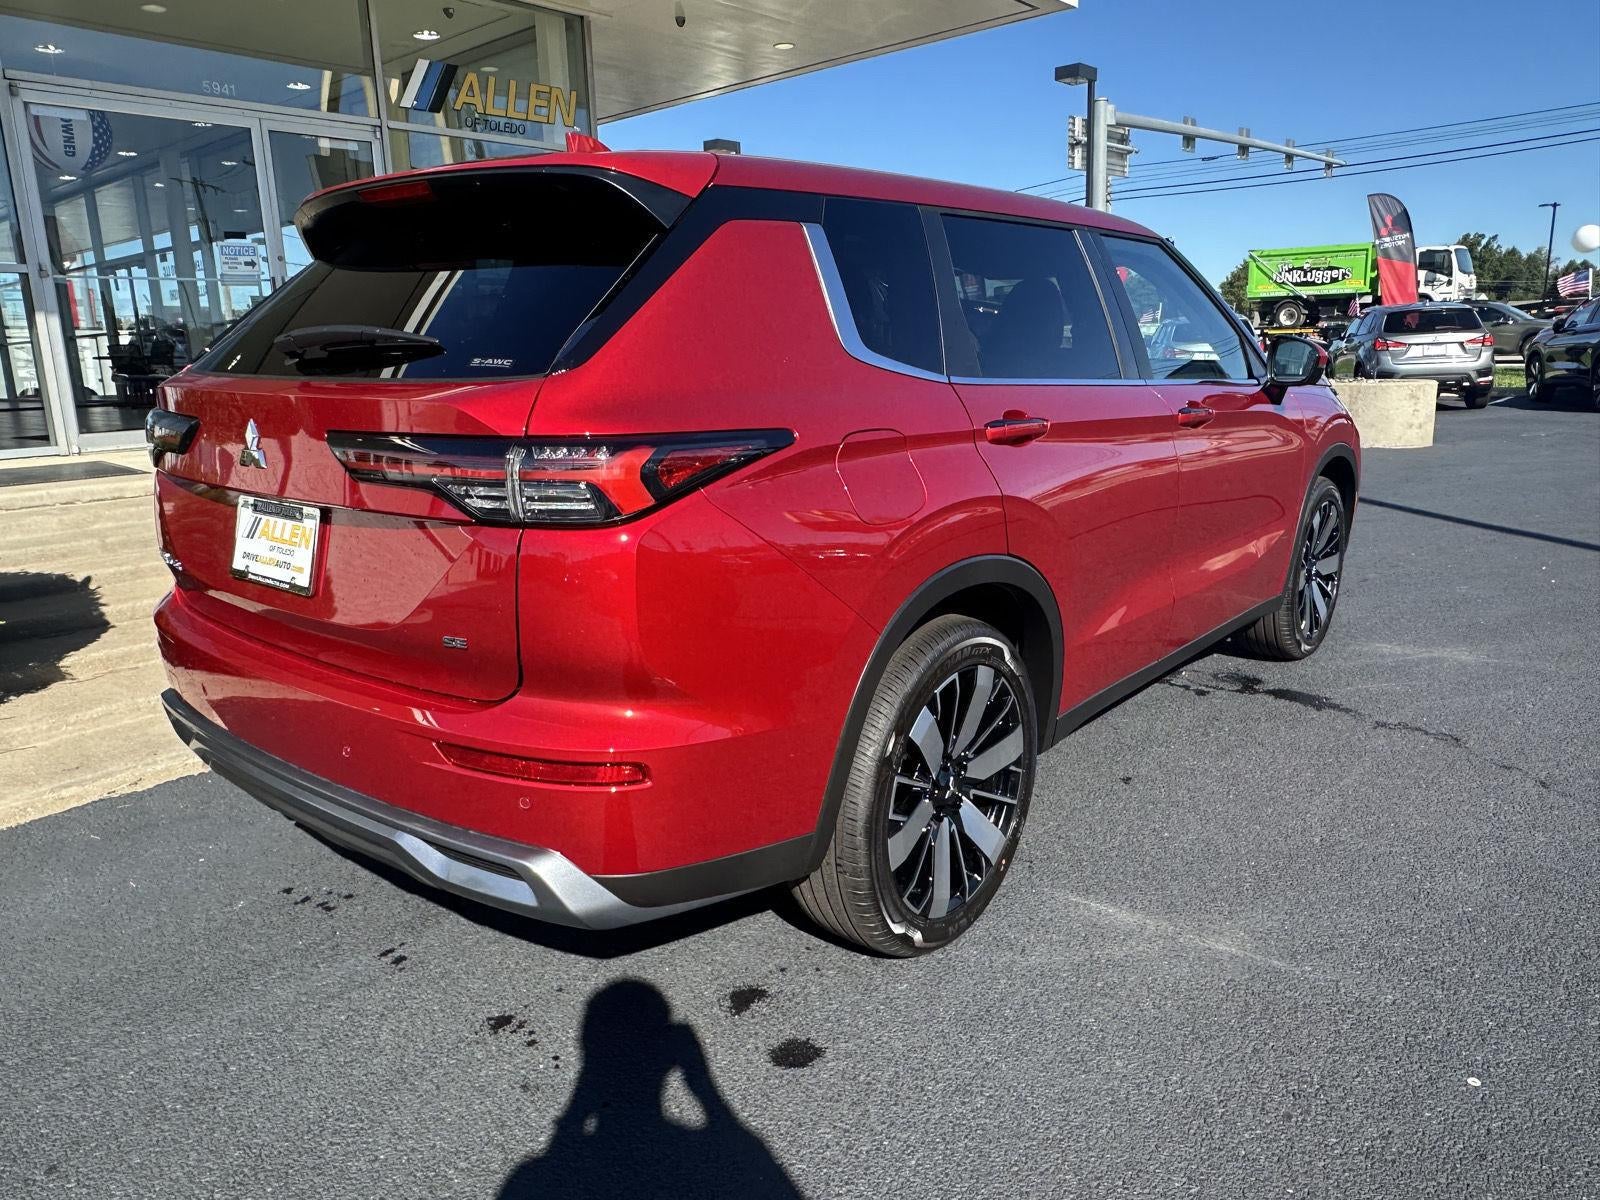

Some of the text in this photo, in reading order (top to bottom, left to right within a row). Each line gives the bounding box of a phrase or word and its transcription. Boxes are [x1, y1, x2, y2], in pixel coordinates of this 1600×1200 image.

[201, 80, 237, 97] 5941
[453, 72, 578, 127] ALLEN
[464, 115, 527, 136] OF TOLEDO
[221, 246, 255, 256] NOTICE
[471, 357, 514, 366] S-AWC
[258, 518, 314, 551] ALLEN
[443, 635, 468, 649] SE
